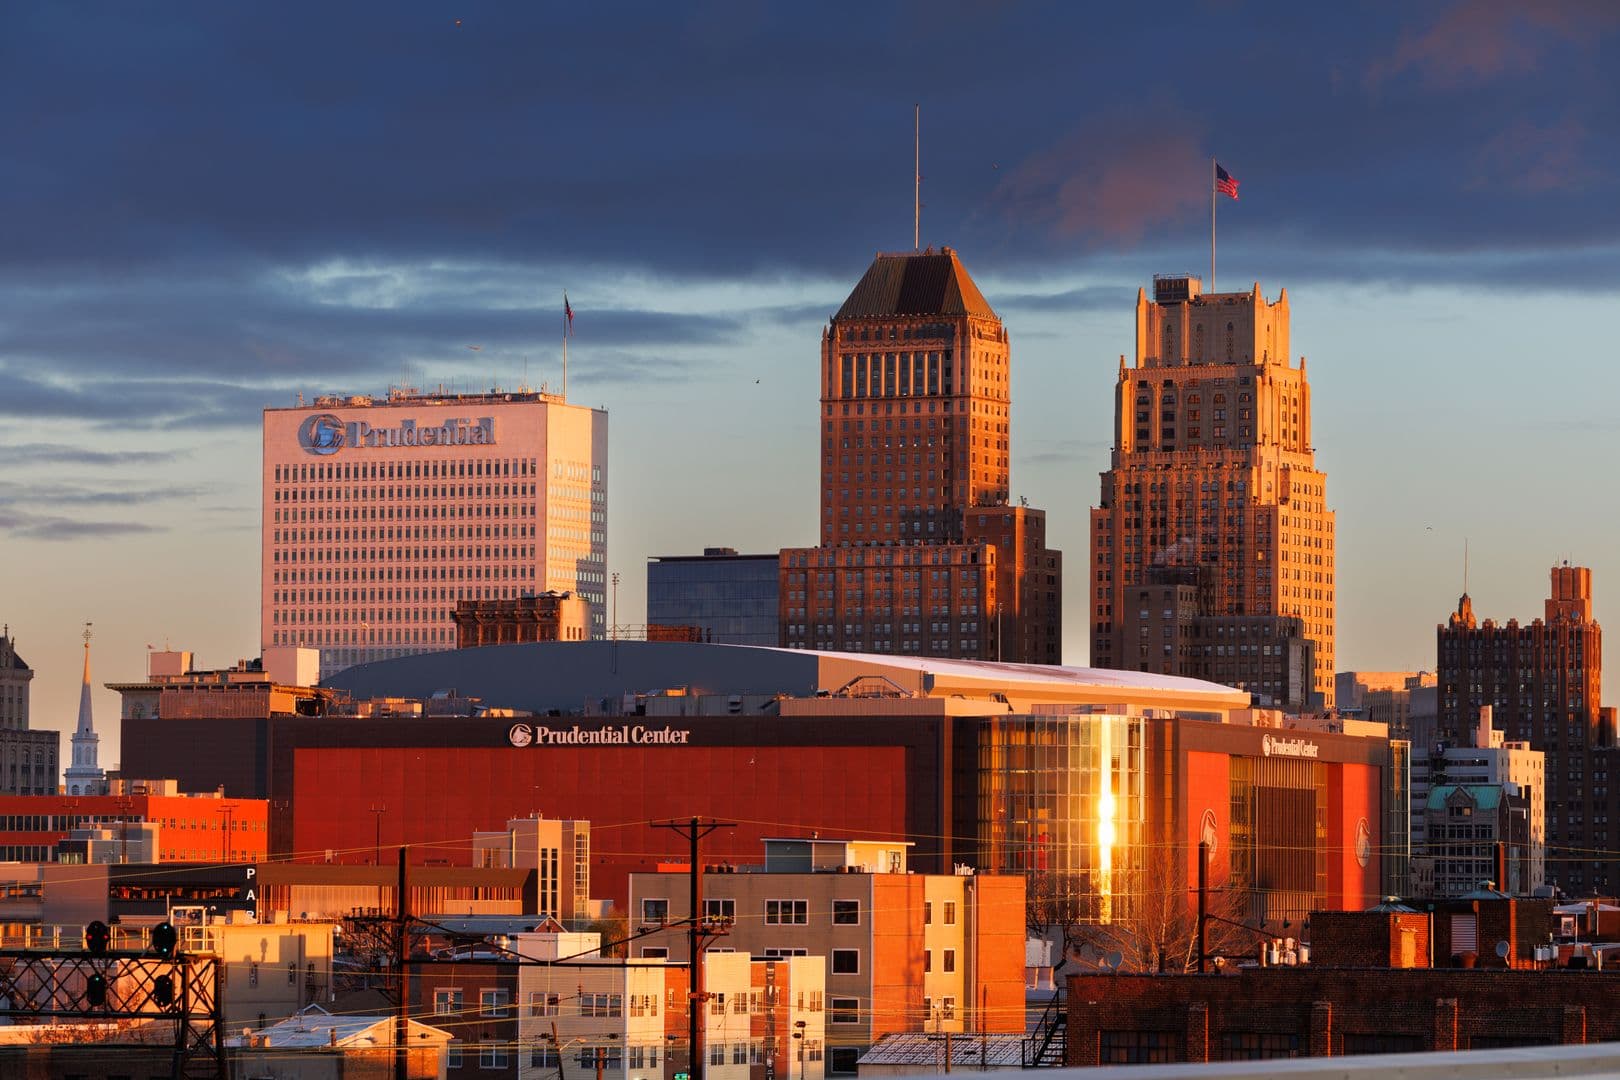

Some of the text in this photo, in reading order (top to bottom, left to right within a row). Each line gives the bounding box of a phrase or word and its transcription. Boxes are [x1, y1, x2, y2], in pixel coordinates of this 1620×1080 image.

[354, 417, 496, 448] Prudential
[535, 725, 690, 744] Prudential Center
